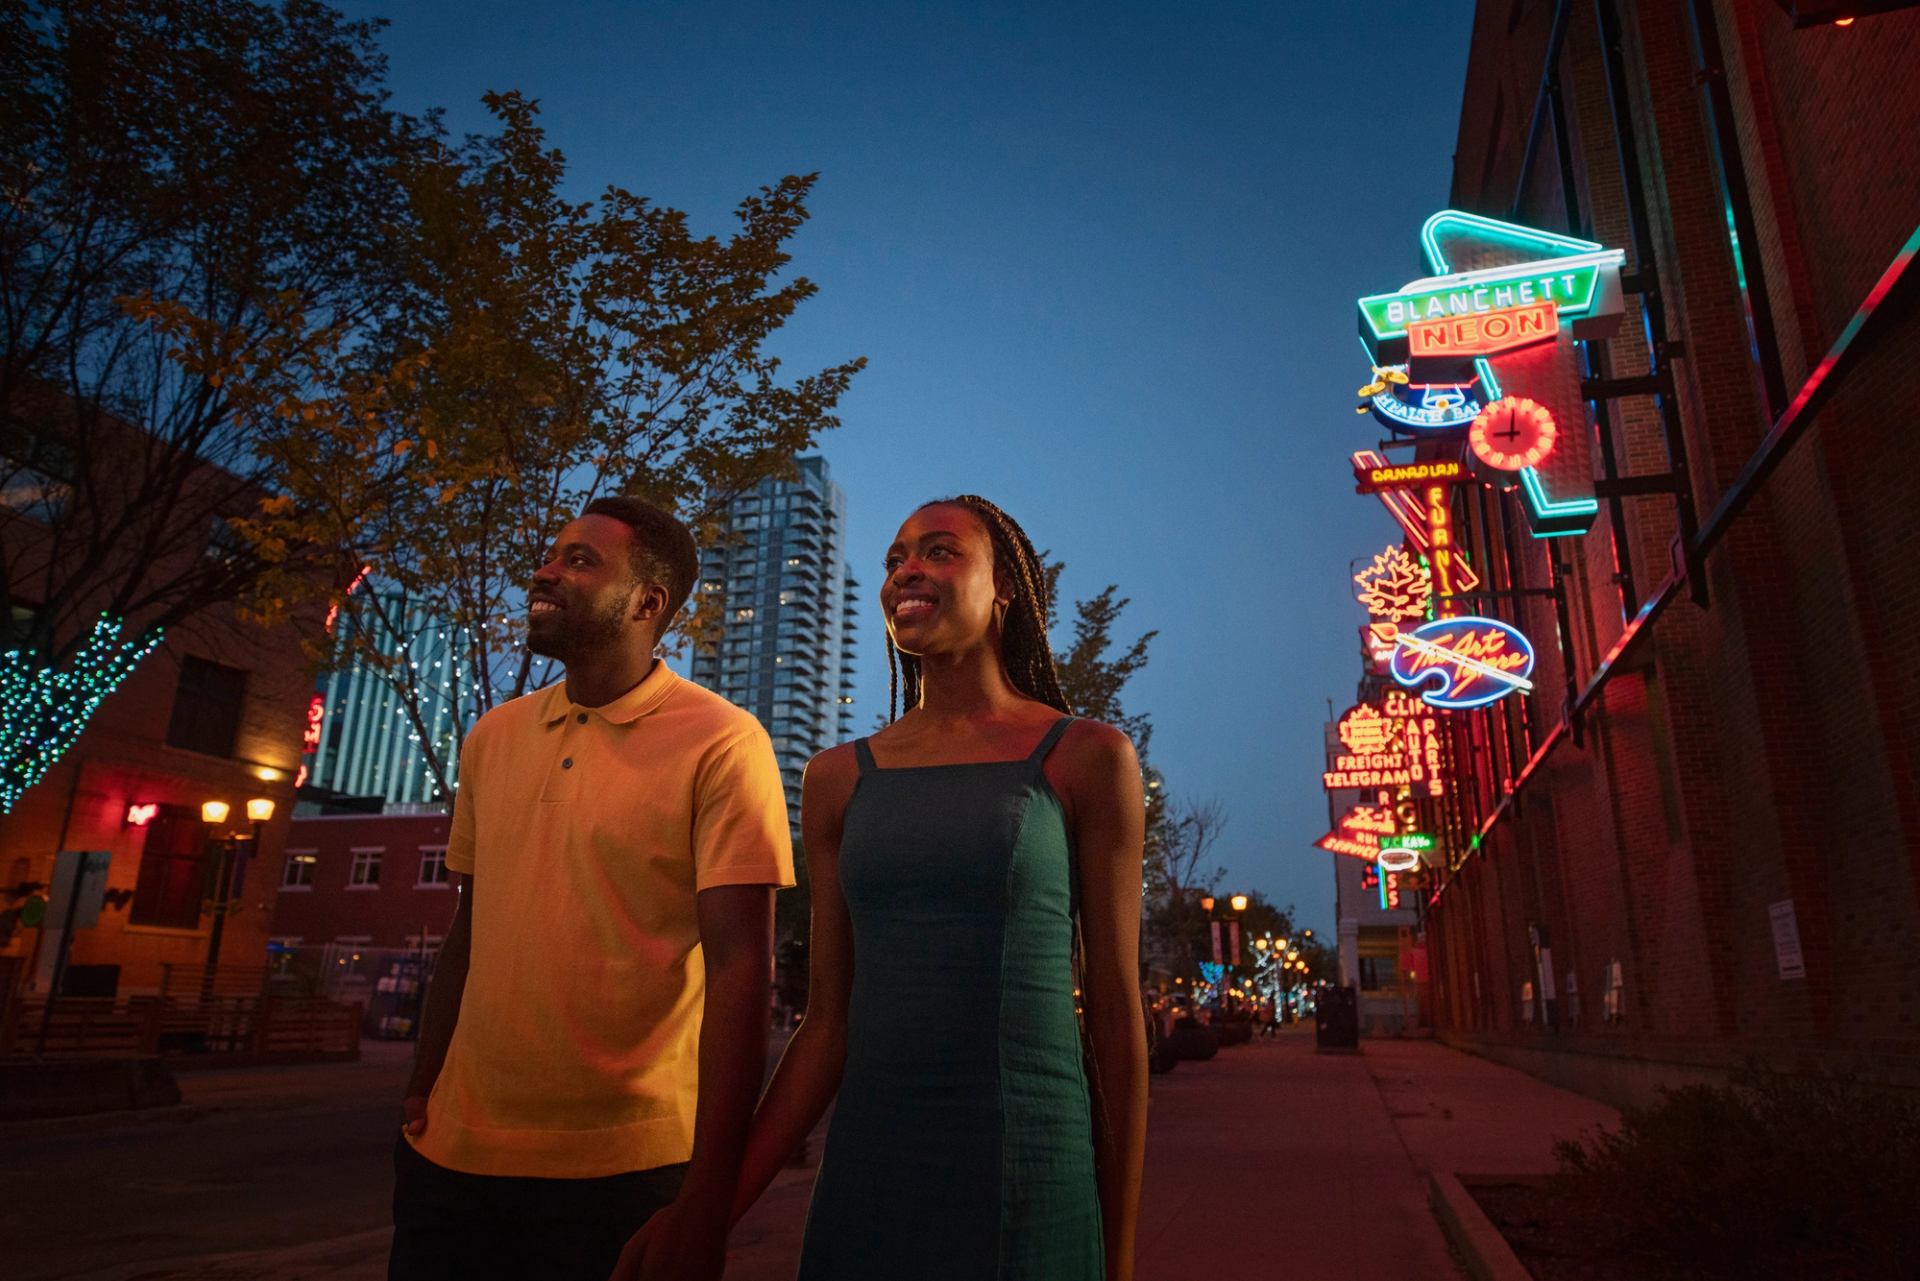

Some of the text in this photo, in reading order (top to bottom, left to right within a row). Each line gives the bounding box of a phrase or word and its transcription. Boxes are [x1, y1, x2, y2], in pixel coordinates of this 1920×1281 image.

[1387, 275, 1576, 322] BLANCHETT
[1421, 310, 1546, 349] NEON
[1376, 393, 1444, 423] HEALTH
[1372, 463, 1459, 481] CANADIAN
[1452, 628, 1505, 657] Art
[1337, 753, 1403, 770] FREIGHT
[1406, 719, 1423, 781] AUTO
[1423, 719, 1443, 796] PARTS
[1323, 770, 1410, 788] TELEGRAM
[1323, 837, 1380, 860] SERVICE
